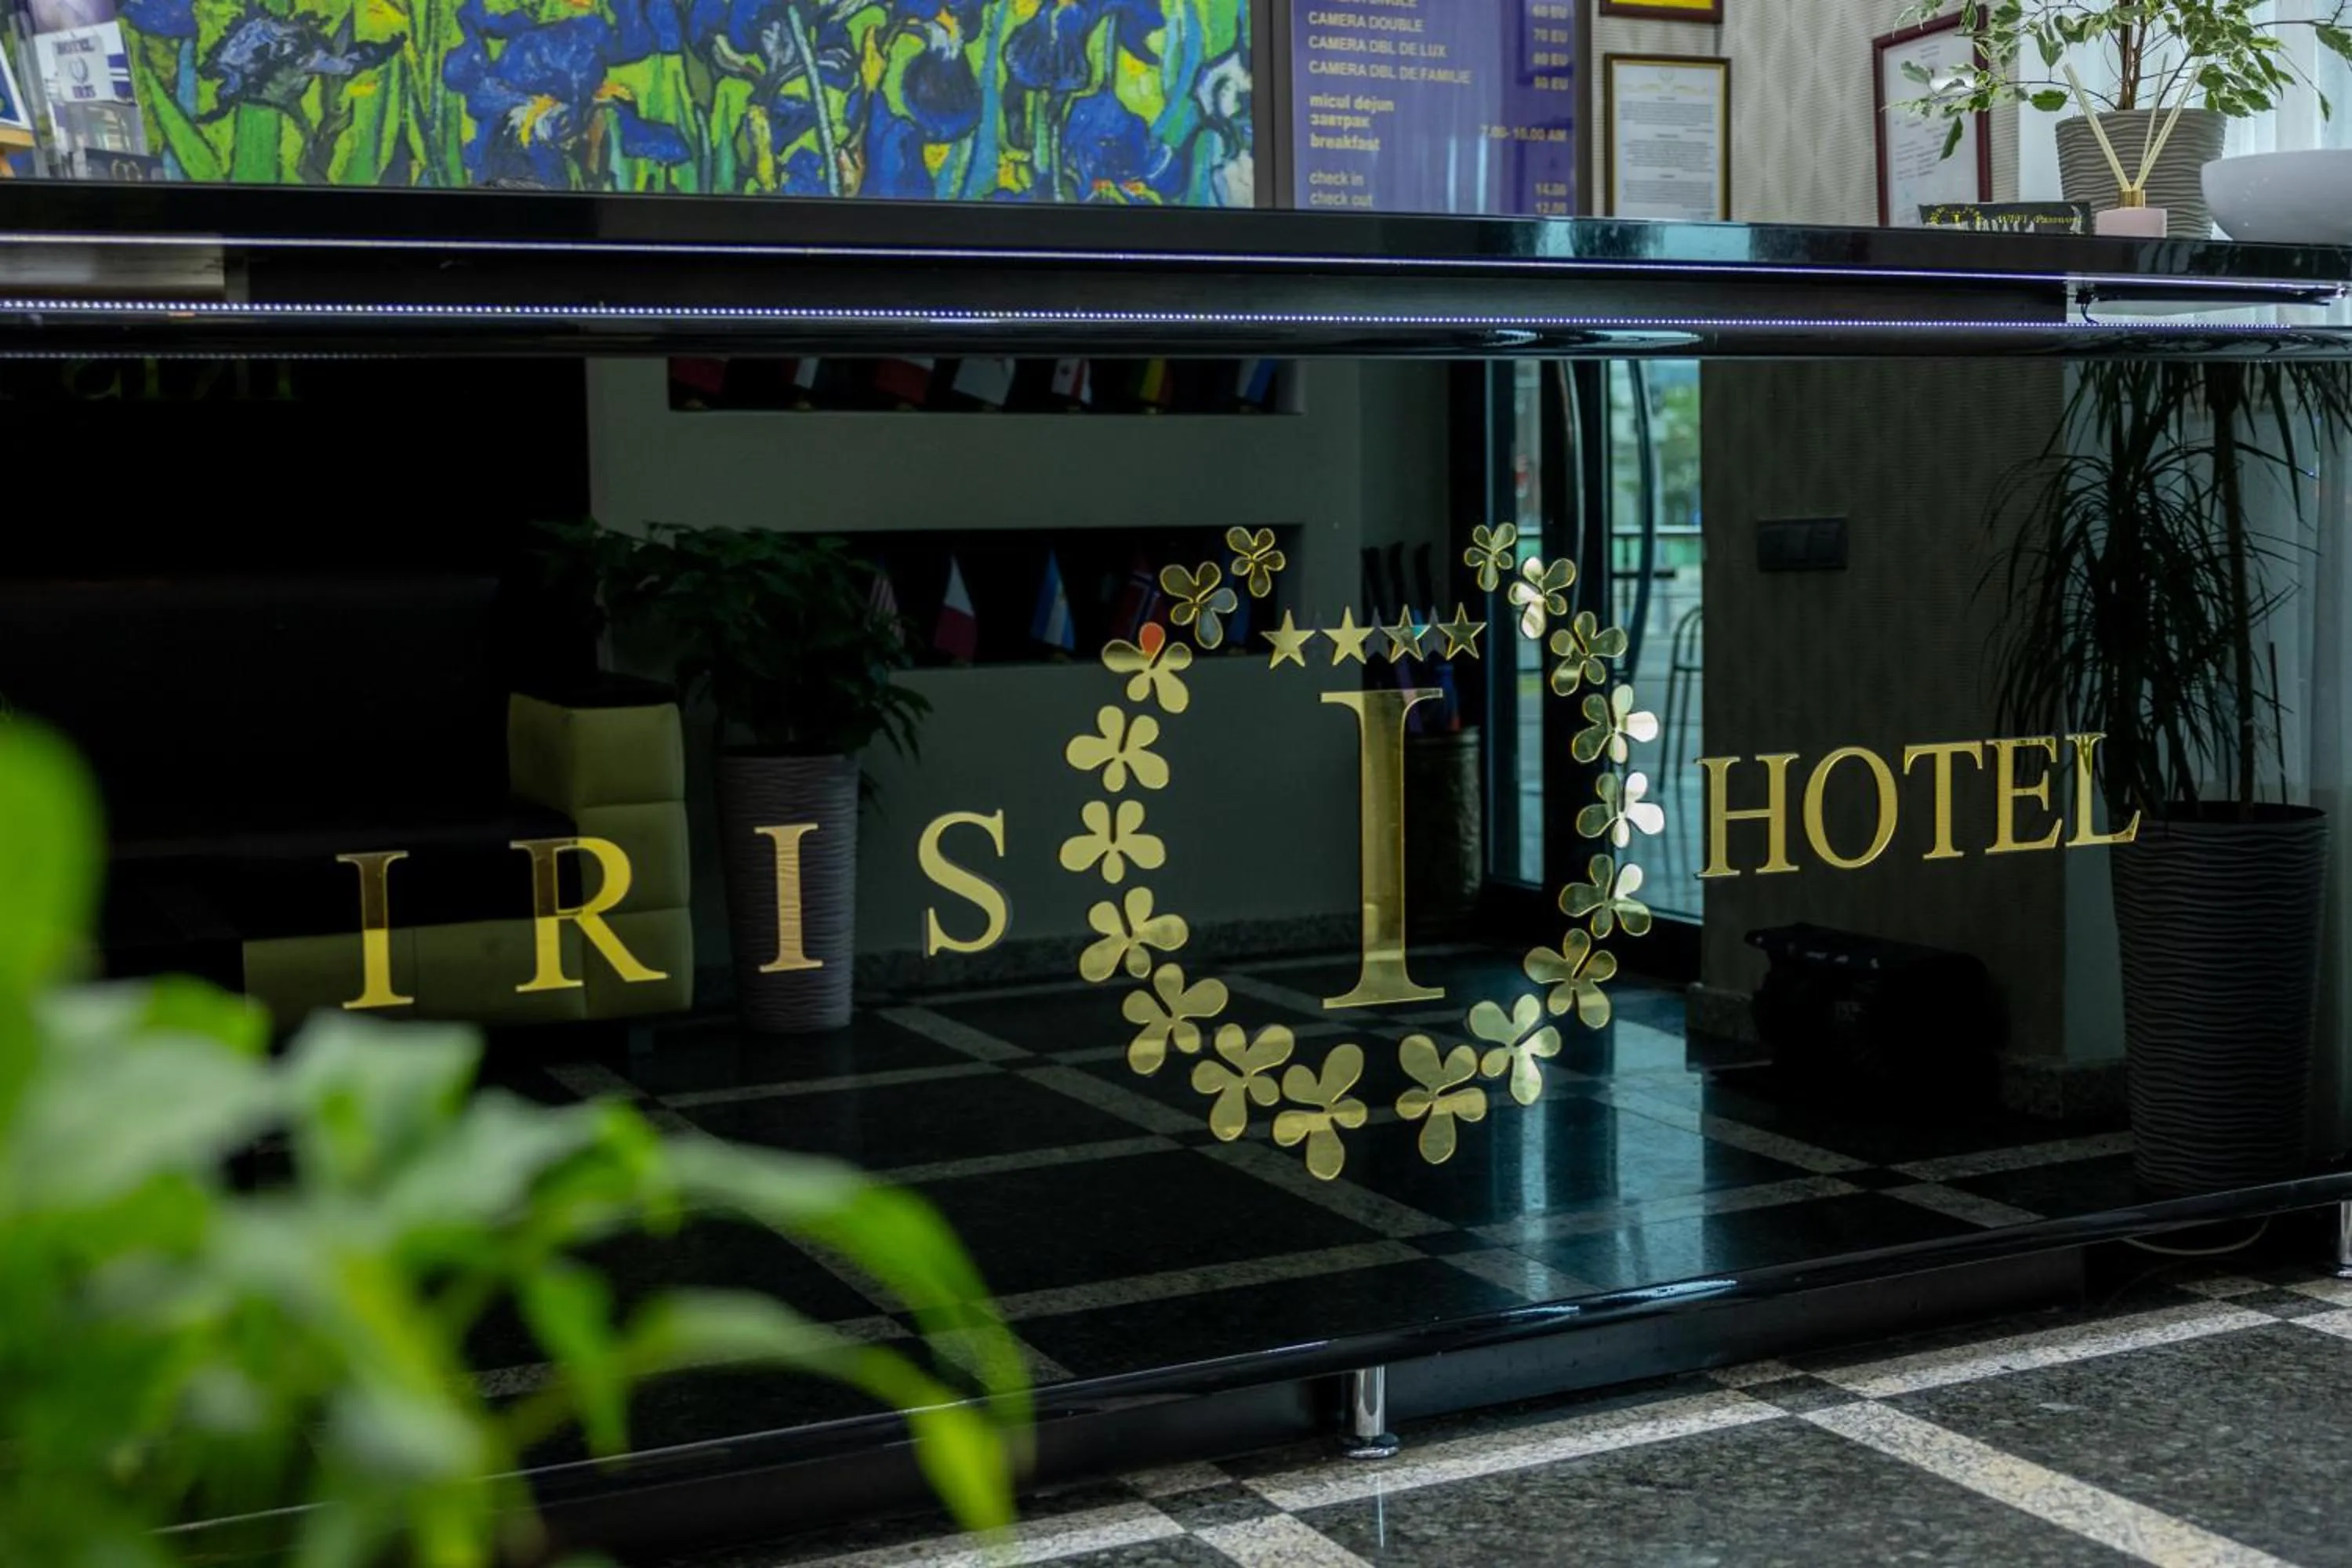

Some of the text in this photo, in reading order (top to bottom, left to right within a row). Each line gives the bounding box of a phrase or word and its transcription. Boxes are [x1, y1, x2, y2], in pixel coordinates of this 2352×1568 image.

[1308, 11, 1366, 28] CAMERA
[1369, 16, 1425, 33] DOUBLE
[1308, 35, 1367, 52] CAMERA
[1369, 39, 1396, 55] DBL
[1399, 42, 1417, 56] DE
[1421, 43, 1447, 58] LUX
[1308, 60, 1367, 77] CAMERA
[1369, 64, 1396, 79] DBL
[1399, 66, 1417, 81] DE
[1309, 93, 1395, 114] micul dejun
[1309, 132, 1381, 152] breakfast
[1309, 169, 1348, 186] check
[1351, 171, 1364, 187] in
[1309, 190, 1348, 206] check
[1352, 192, 1374, 208] out
[1695, 733, 2141, 877] HOTEL
[1320, 688, 1446, 1009] I
[336, 809, 1007, 1009] IRIS
